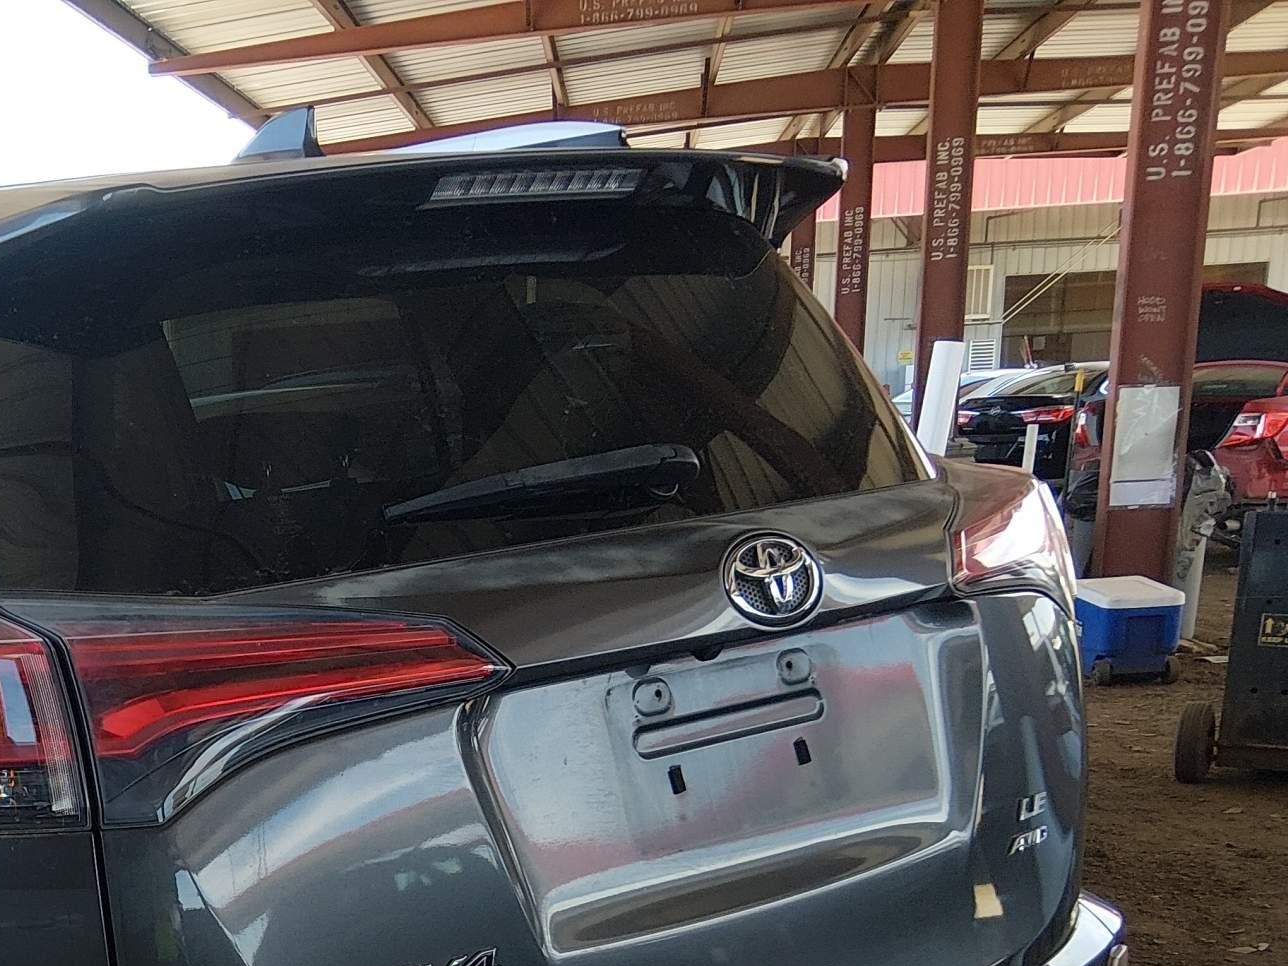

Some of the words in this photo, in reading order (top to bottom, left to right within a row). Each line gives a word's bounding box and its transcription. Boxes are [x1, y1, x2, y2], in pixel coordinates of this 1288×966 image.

[1150, 27, 1182, 122] PREFAB
[1145, 134, 1171, 181] U.S.
[933, 171, 948, 227] PREFAB
[945, 137, 965, 258] 1-866-799-0969
[842, 230, 853, 270] PREFAB
[851, 206, 865, 293] 1-866-799-0969
[1018, 791, 1048, 821] LE
